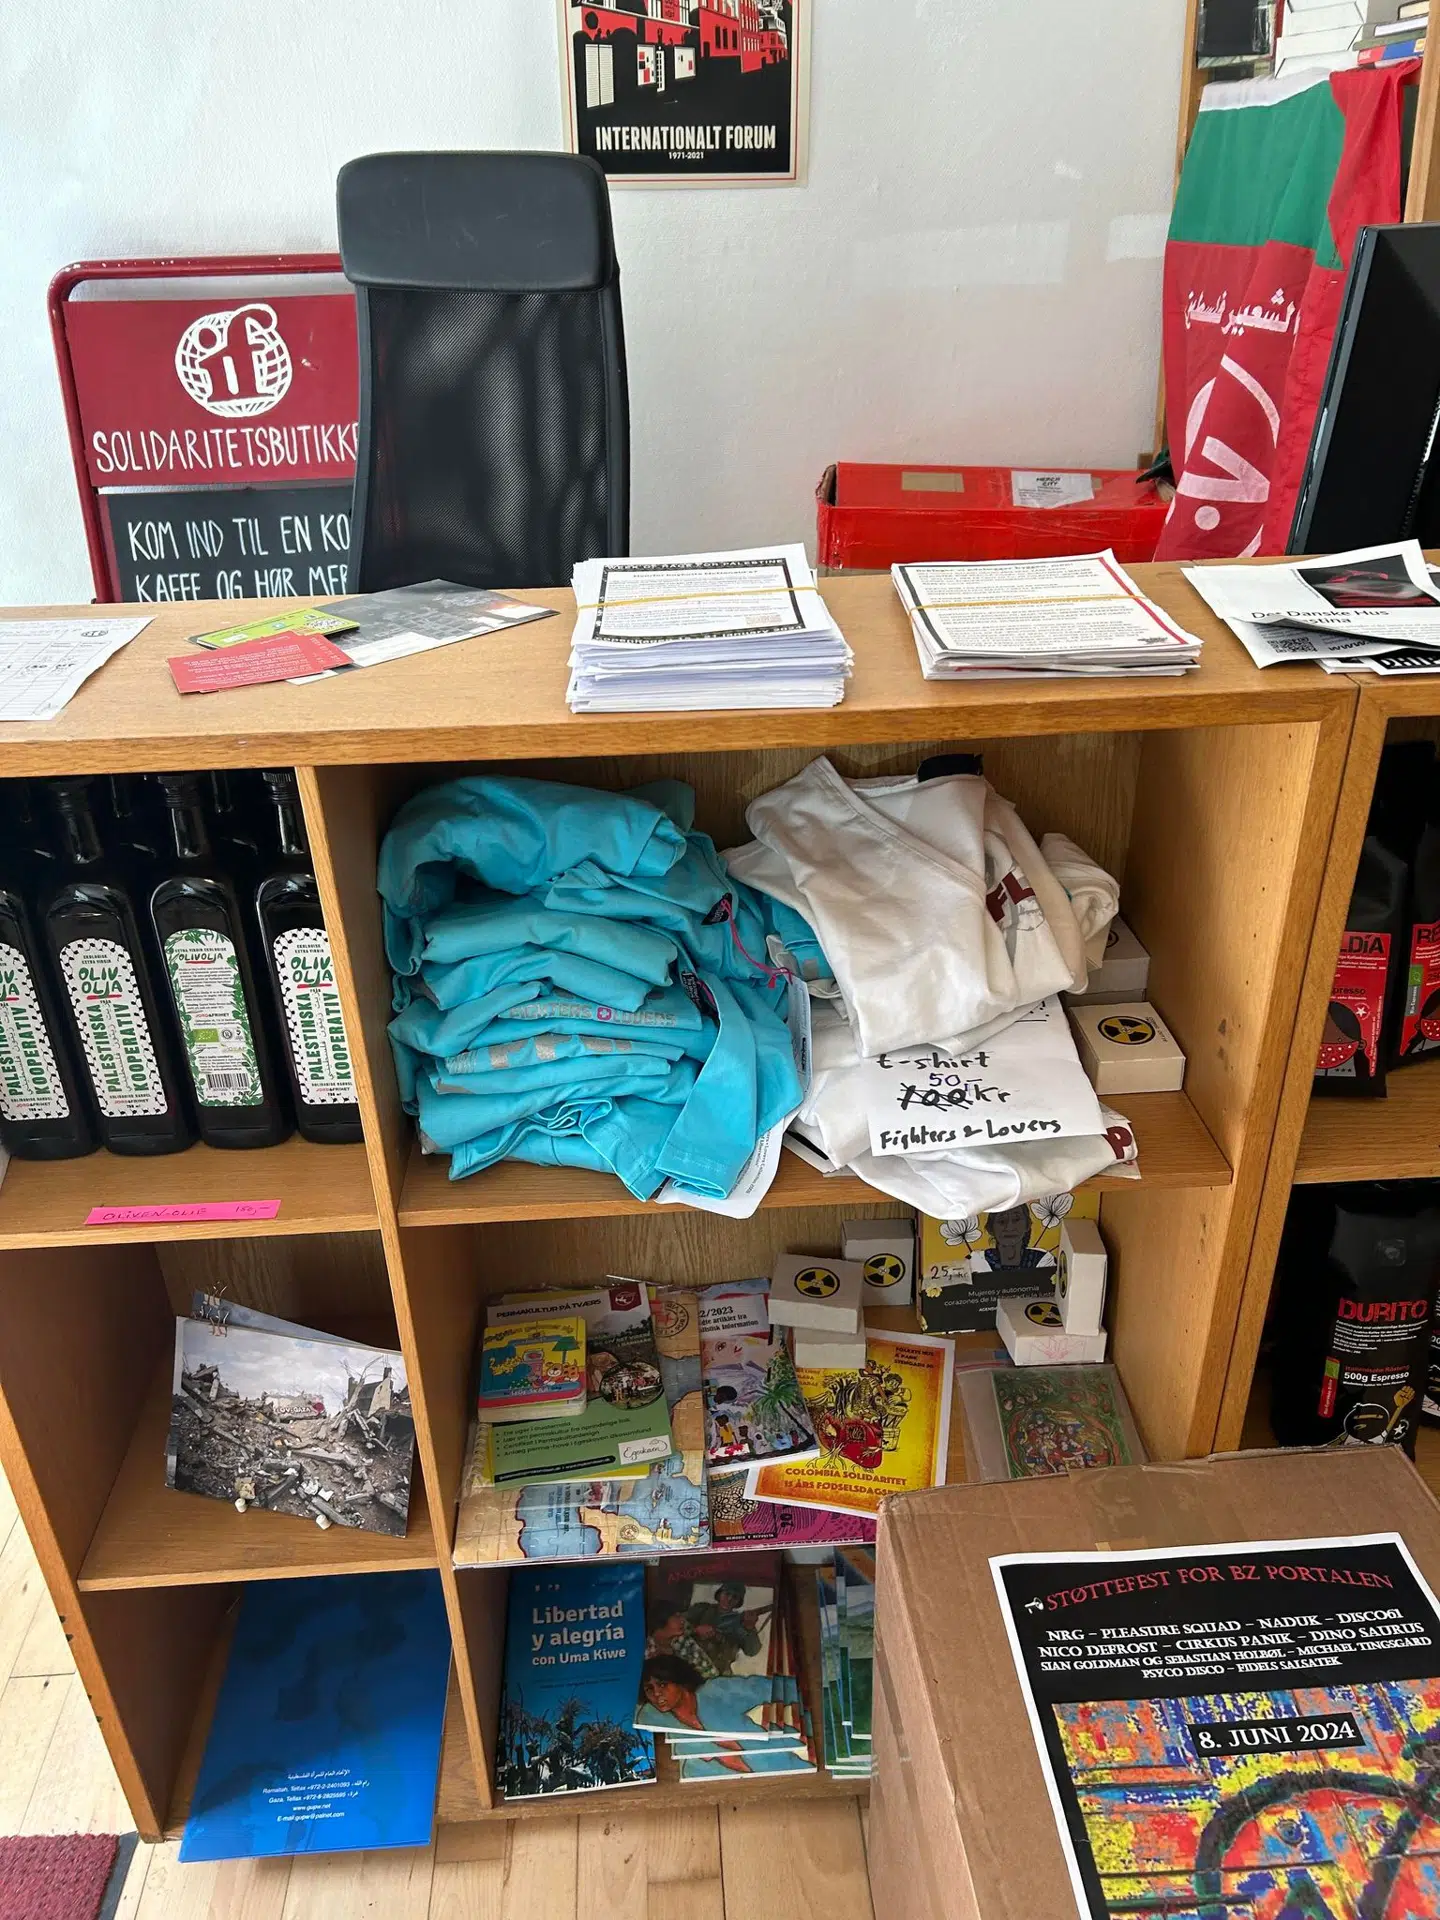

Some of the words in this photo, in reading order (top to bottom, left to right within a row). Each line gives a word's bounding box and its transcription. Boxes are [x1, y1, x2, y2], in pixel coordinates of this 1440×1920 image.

[596, 126, 722, 150] INTERNATIONALT
[726, 126, 776, 150] FORUM
[668, 152, 704, 160] 1971-2021
[128, 520, 180, 561] KOM
[185, 518, 224, 558] IND
[232, 517, 269, 556] TIL
[280, 516, 312, 555] EN
[216, 570, 244, 599] OG
[254, 564, 292, 598] HØR
[1286, 610, 1350, 618] Danske
[178, 953, 224, 963] OLIVOLJA
[82, 980, 123, 998] OLJA
[292, 970, 333, 988] OLJA
[113, 1004, 150, 1091] KOOPERATIV
[296, 993, 324, 1080] PALESTINSKA
[322, 992, 352, 1080] KOOPERATIV
[11, 1006, 50, 1095] KOOPERATIV
[86, 1004, 118, 1093] PALESTINSKA
[986, 1118, 1061, 1138] Lovers
[496, 1306, 558, 1319] PERMAKULTUR
[558, 1302, 572, 1312] PÅ
[572, 1299, 602, 1310] TVÆRS
[944, 1298, 979, 1306] corazones
[1338, 1298, 1429, 1322] DURITO
[722, 1320, 759, 1330] Information
[1344, 1372, 1368, 1382] 500g
[1370, 1372, 1410, 1382] Espresso
[785, 1467, 841, 1479] COLOMBIA
[842, 1470, 907, 1486] SOLIDARITET
[796, 1478, 815, 1489] ÅRS
[1046, 1570, 1171, 1611] STØTTEFEST
[1178, 1566, 1226, 1586] FOR
[1228, 1565, 1260, 1581] BZ
[1266, 1564, 1394, 1589] PORTALEN
[532, 1600, 624, 1624] Libertad
[1046, 1628, 1084, 1642] NRG
[1101, 1624, 1180, 1640] PLEASURE
[1183, 1620, 1242, 1635] SQUAD
[1259, 1614, 1322, 1630] NADUK
[1336, 1608, 1404, 1624] DISCO61
[531, 1632, 544, 1652] y
[550, 1623, 625, 1647] alegría
[1038, 1643, 1084, 1658] NICO
[1086, 1640, 1158, 1656] DEFROST
[1176, 1635, 1236, 1652] CIRKUS
[1239, 1632, 1295, 1646] PANIK
[1308, 1627, 1359, 1642] DINO
[1360, 1622, 1425, 1638] SAURUS
[532, 1656, 556, 1665] con
[560, 1652, 590, 1664] Uma
[594, 1648, 626, 1660] Kiwe
[1040, 1660, 1071, 1671] SIAN
[1073, 1657, 1140, 1670] GOLDMAN
[1143, 1656, 1162, 1666] OG
[1164, 1650, 1230, 1666] SEBASTIAN
[1232, 1647, 1286, 1661] HOLBØL
[1298, 1643, 1356, 1657] MICHAEL
[1359, 1635, 1432, 1652] TINGSGÅRD
[1142, 1667, 1184, 1679] PSYCO
[1186, 1664, 1225, 1676] DISCO
[1238, 1660, 1279, 1674] FIDELS
[1280, 1655, 1343, 1670] SALSATEK
[1199, 1730, 1222, 1750] 8.
[1228, 1724, 1292, 1748] JUNI
[1299, 1720, 1356, 1743] 2024
